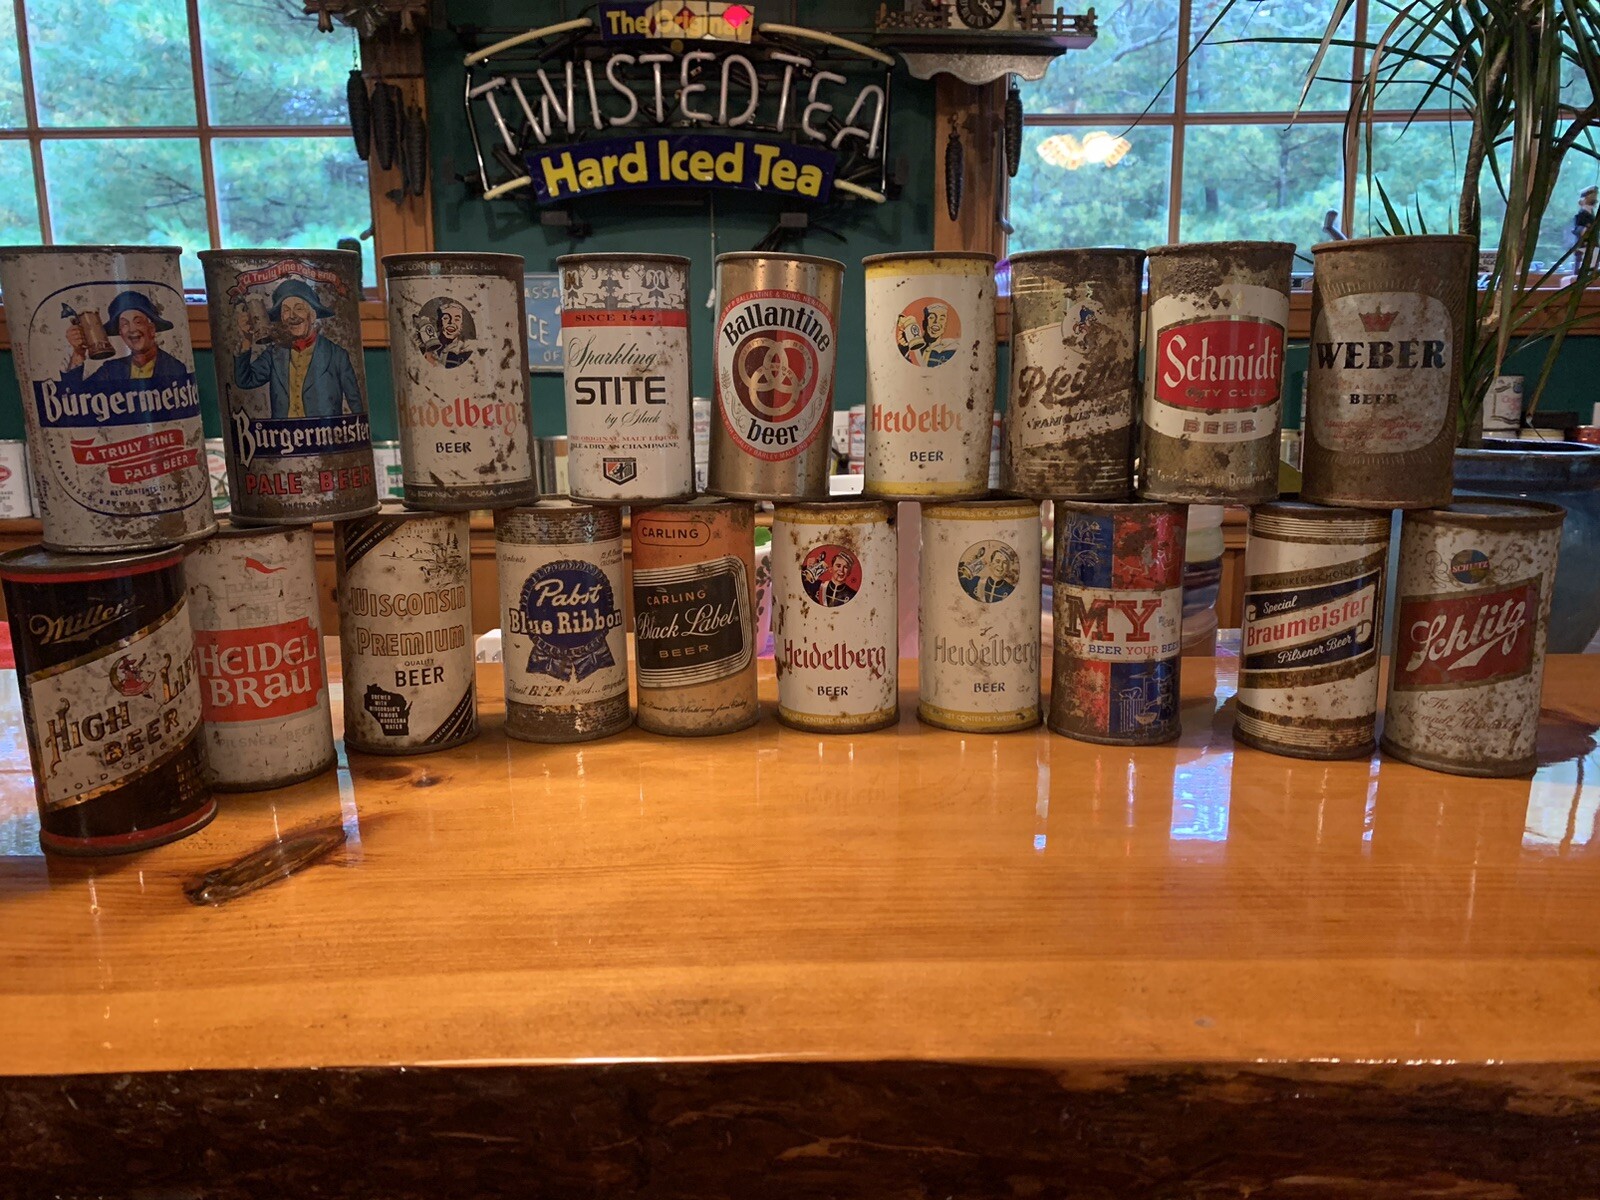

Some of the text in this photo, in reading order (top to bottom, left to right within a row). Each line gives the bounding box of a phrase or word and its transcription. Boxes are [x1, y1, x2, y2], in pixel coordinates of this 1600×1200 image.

[606, 10, 650, 35] The
[468, 52, 886, 158] TWISTED TEA
[540, 140, 823, 198] Hard Iced Tea
[277, 262, 296, 275] Fine
[735, 289, 774, 303] BALLANTINE
[575, 313, 656, 322] SINCE 1847
[722, 302, 831, 353] Ballantine
[568, 333, 658, 374] Sparkling
[1163, 334, 1279, 388] Schmidt
[1316, 339, 1447, 370] WEBER
[574, 376, 667, 405] STITE
[1185, 388, 1267, 399] CTY CLUB
[1349, 393, 1399, 405] BEER
[604, 413, 618, 429] by
[746, 417, 799, 446] beer
[1183, 418, 1257, 435] BEER
[85, 432, 175, 461] A TRULY FINE
[435, 441, 472, 453] BEER
[909, 450, 944, 462] BEER
[124, 454, 189, 480] PALE BEER
[245, 472, 304, 496] PALE
[318, 464, 372, 493] BEER
[642, 526, 699, 539] CARLING
[1452, 561, 1488, 573] SCHLTZ
[350, 585, 466, 617] WISCONSIN
[534, 578, 603, 607] Pabst
[646, 589, 707, 606] CARLING
[1263, 595, 1298, 614] Special
[29, 602, 130, 646] Miller
[509, 607, 622, 635] Blue Ribbon
[637, 598, 737, 640] Black Label
[1064, 594, 1162, 642] MY
[1246, 594, 1372, 648] Braumeister
[356, 624, 465, 656] PREMIUM
[1277, 633, 1353, 664] Pilsener Beer
[1405, 598, 1526, 672] Schlitz
[197, 635, 317, 677] HEIDEL
[404, 658, 435, 667] QUALITY
[659, 644, 711, 658] BEER
[784, 638, 887, 680] Heidelberg
[934, 634, 1038, 674] Heidelberg
[1088, 644, 1122, 655] BEER
[1125, 646, 1159, 656] YOUR
[395, 666, 445, 687] BEER
[817, 685, 849, 696] BEER
[973, 682, 1006, 693] BEER
[45, 698, 133, 778] HIGH
[102, 707, 180, 766] BEER
